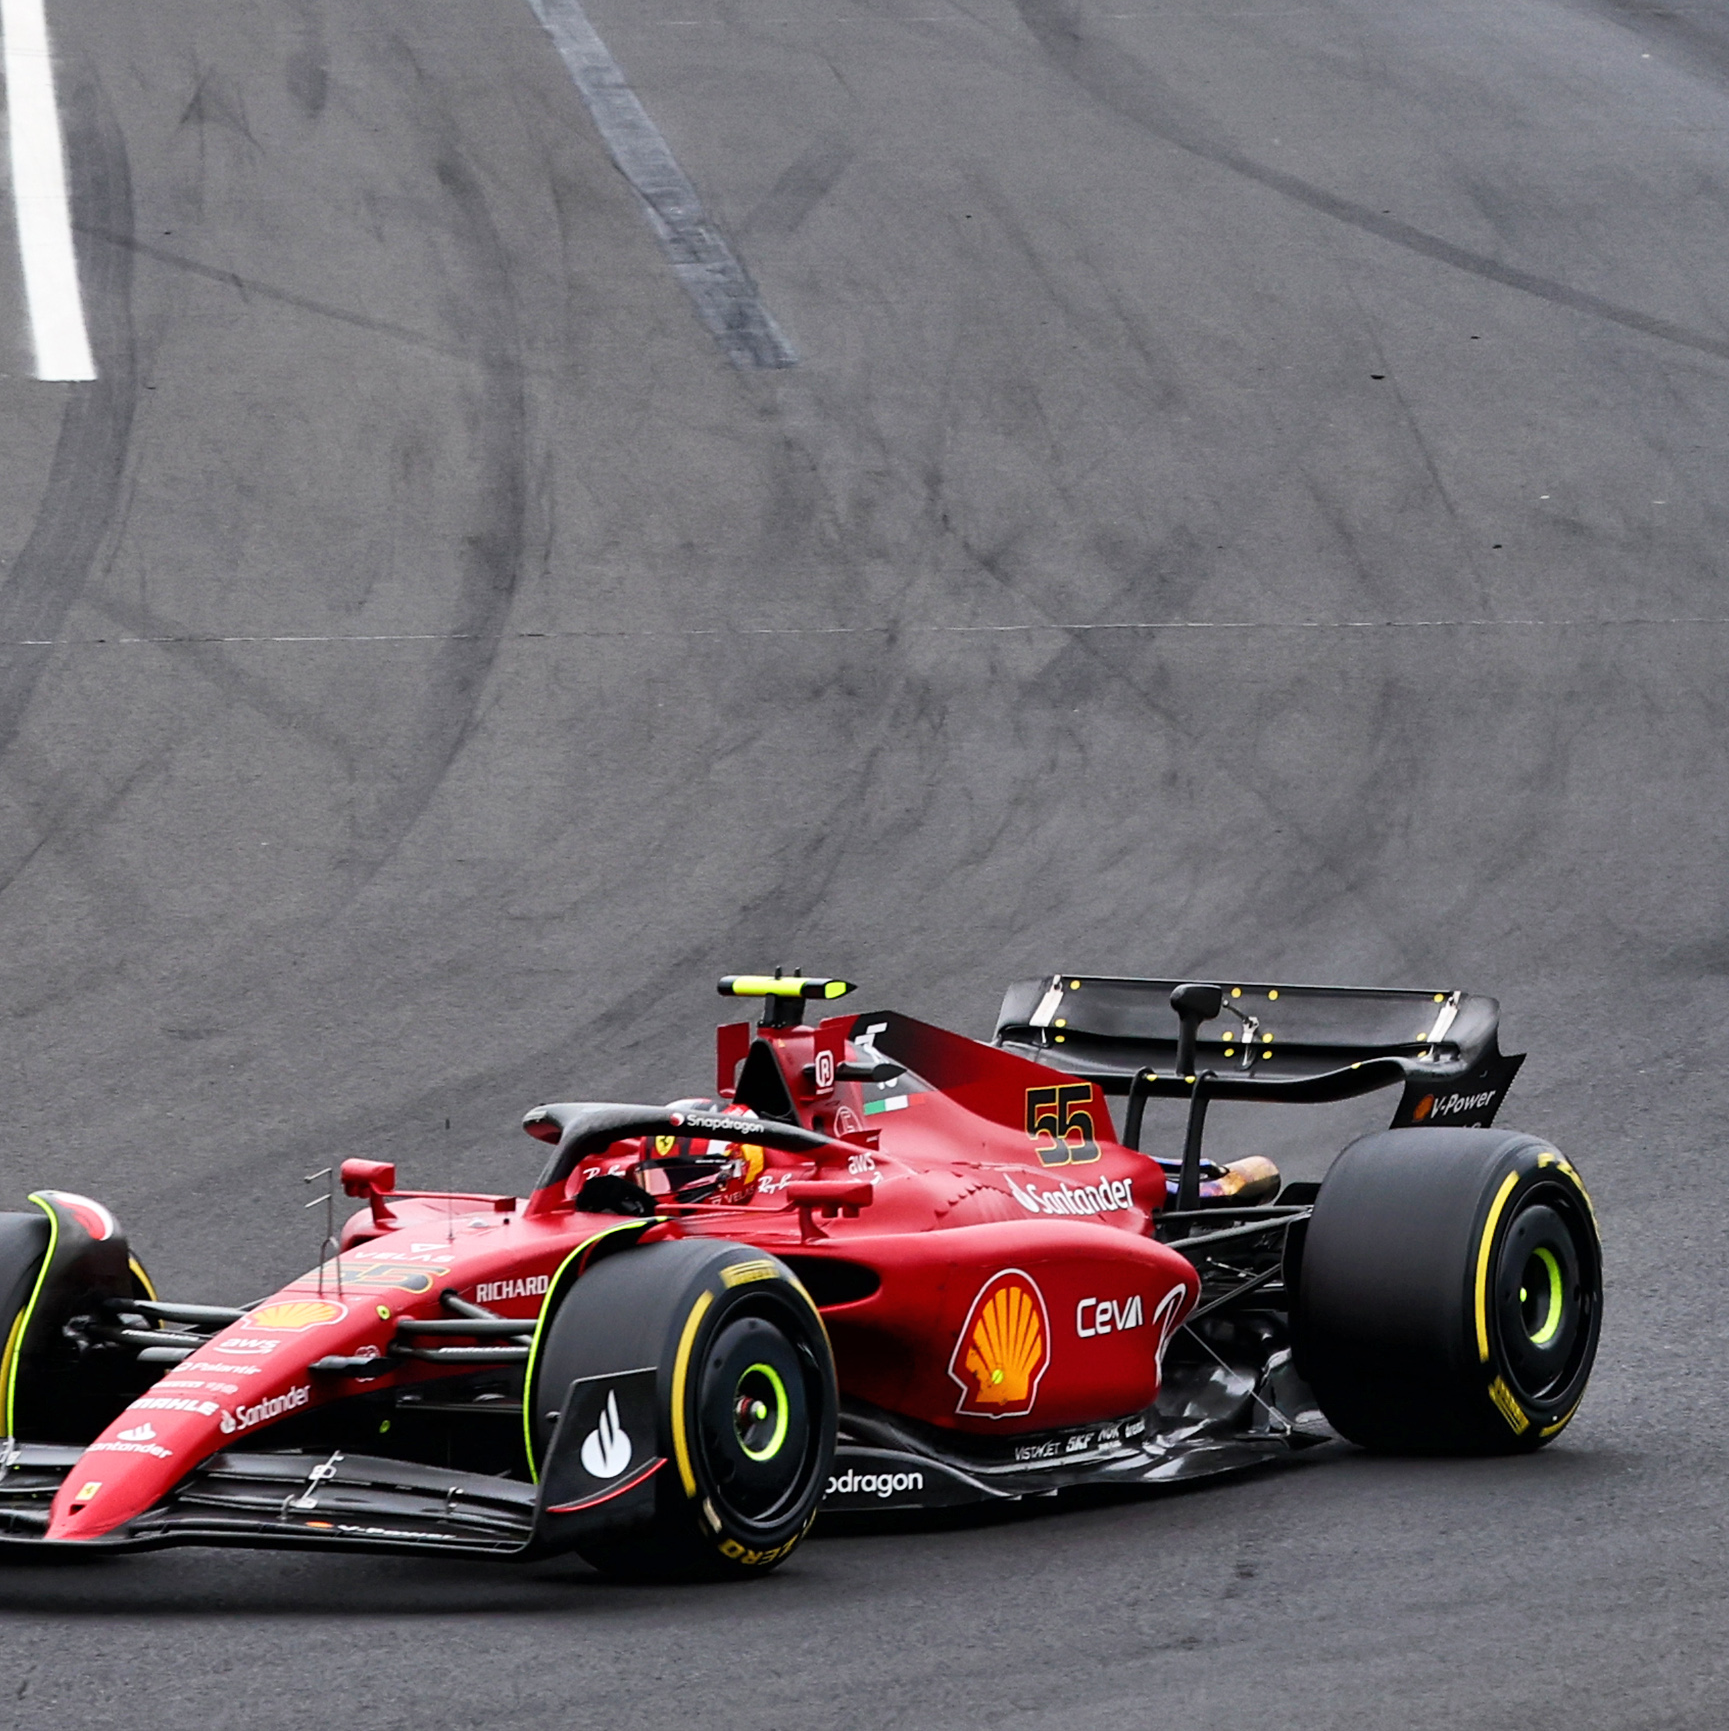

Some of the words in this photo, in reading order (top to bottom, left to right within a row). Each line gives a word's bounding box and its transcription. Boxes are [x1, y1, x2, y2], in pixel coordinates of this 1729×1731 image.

[1431, 1090, 1496, 1119] V-Power
[687, 1114, 765, 1134] Snapdragon
[1025, 1083, 1101, 1167] 55
[848, 1153, 876, 1175] aws
[1035, 1176, 1133, 1216] Santander
[354, 1251, 456, 1263] VELAS
[476, 1275, 549, 1303] RICHARD
[189, 1362, 262, 1375] Palantir
[125, 1397, 220, 1417] MAHLE
[236, 1384, 311, 1430] Santander
